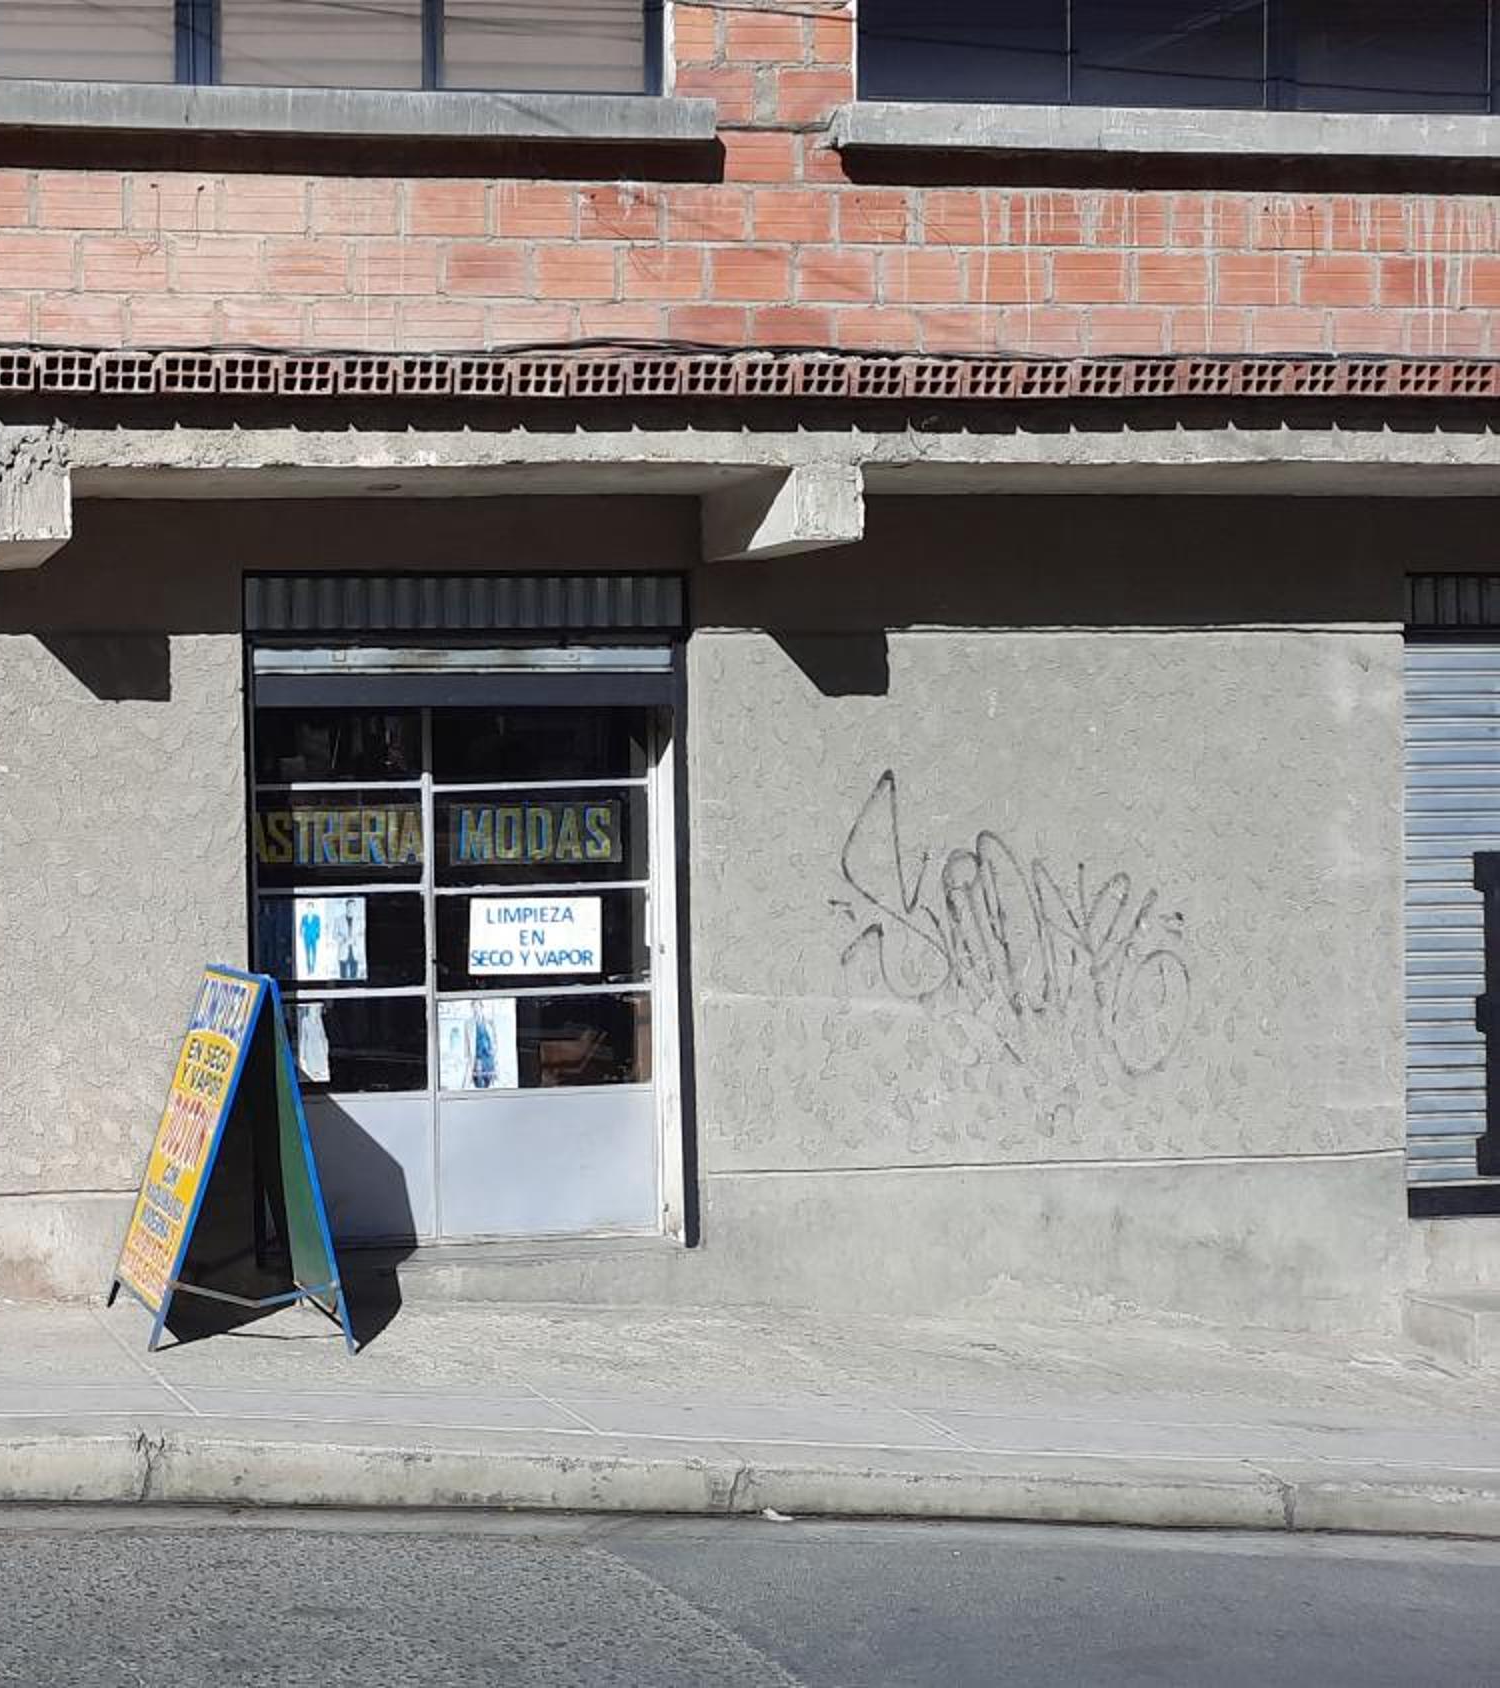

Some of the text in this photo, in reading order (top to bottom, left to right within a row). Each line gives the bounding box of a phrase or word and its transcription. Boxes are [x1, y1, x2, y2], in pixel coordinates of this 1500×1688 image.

[460, 807, 611, 860] MODAS
[486, 906, 575, 924] LIMPIEZA
[519, 929, 545, 946] EN
[470, 949, 594, 967] SECO Y VAPOR
[187, 1037, 232, 1073] EN SECO
